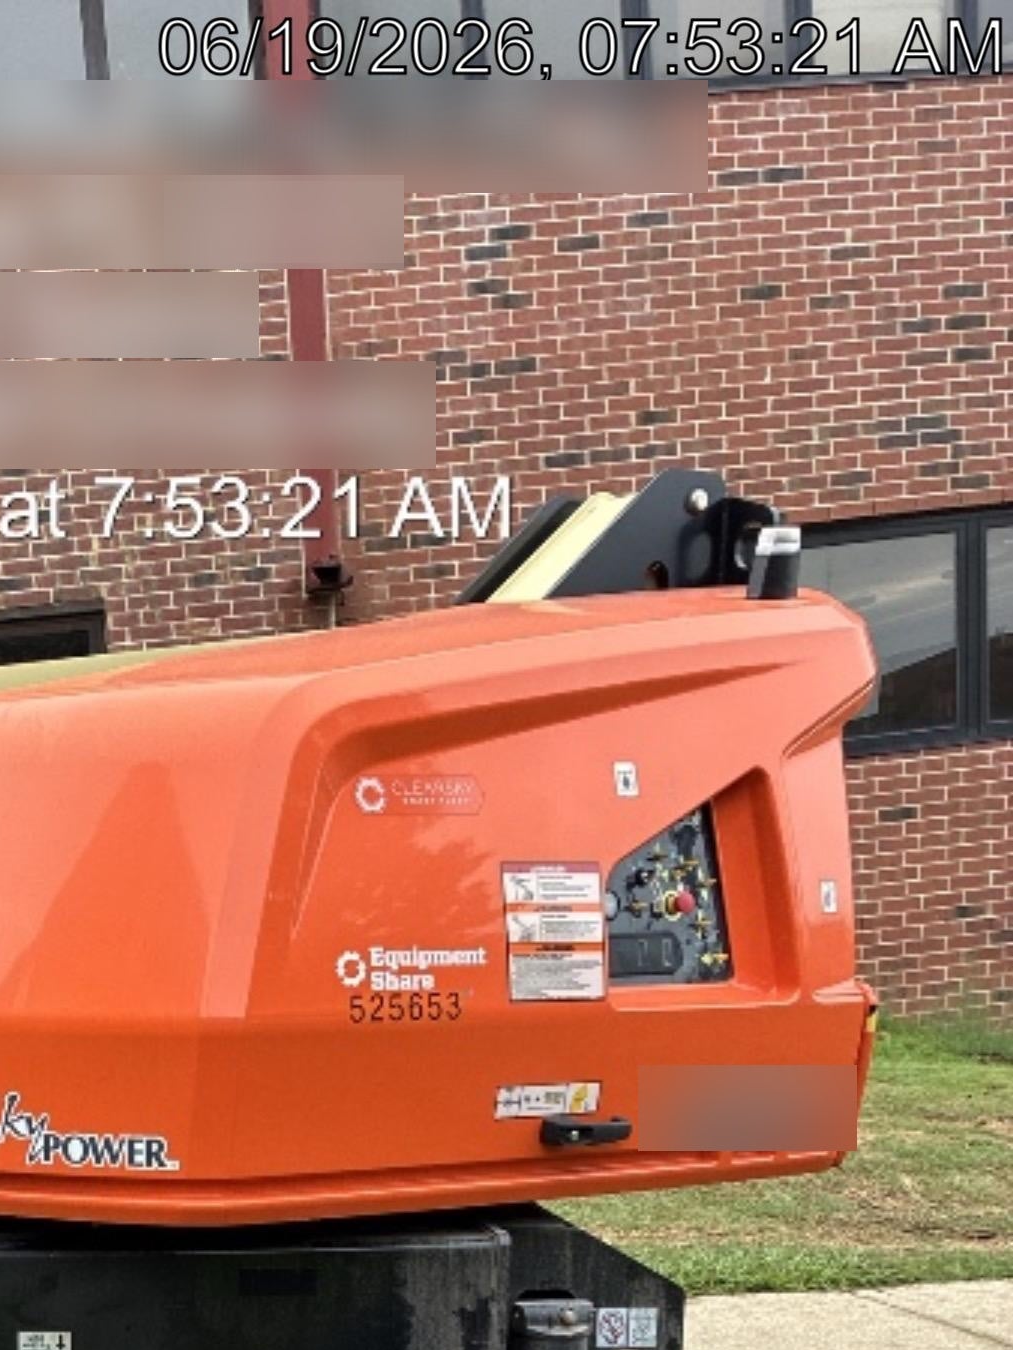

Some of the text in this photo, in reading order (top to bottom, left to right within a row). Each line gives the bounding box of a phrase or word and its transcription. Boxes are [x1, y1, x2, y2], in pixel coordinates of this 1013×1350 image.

[369, 945, 487, 970] Equipment
[370, 971, 435, 991] Share
[349, 992, 462, 1024] 525653
